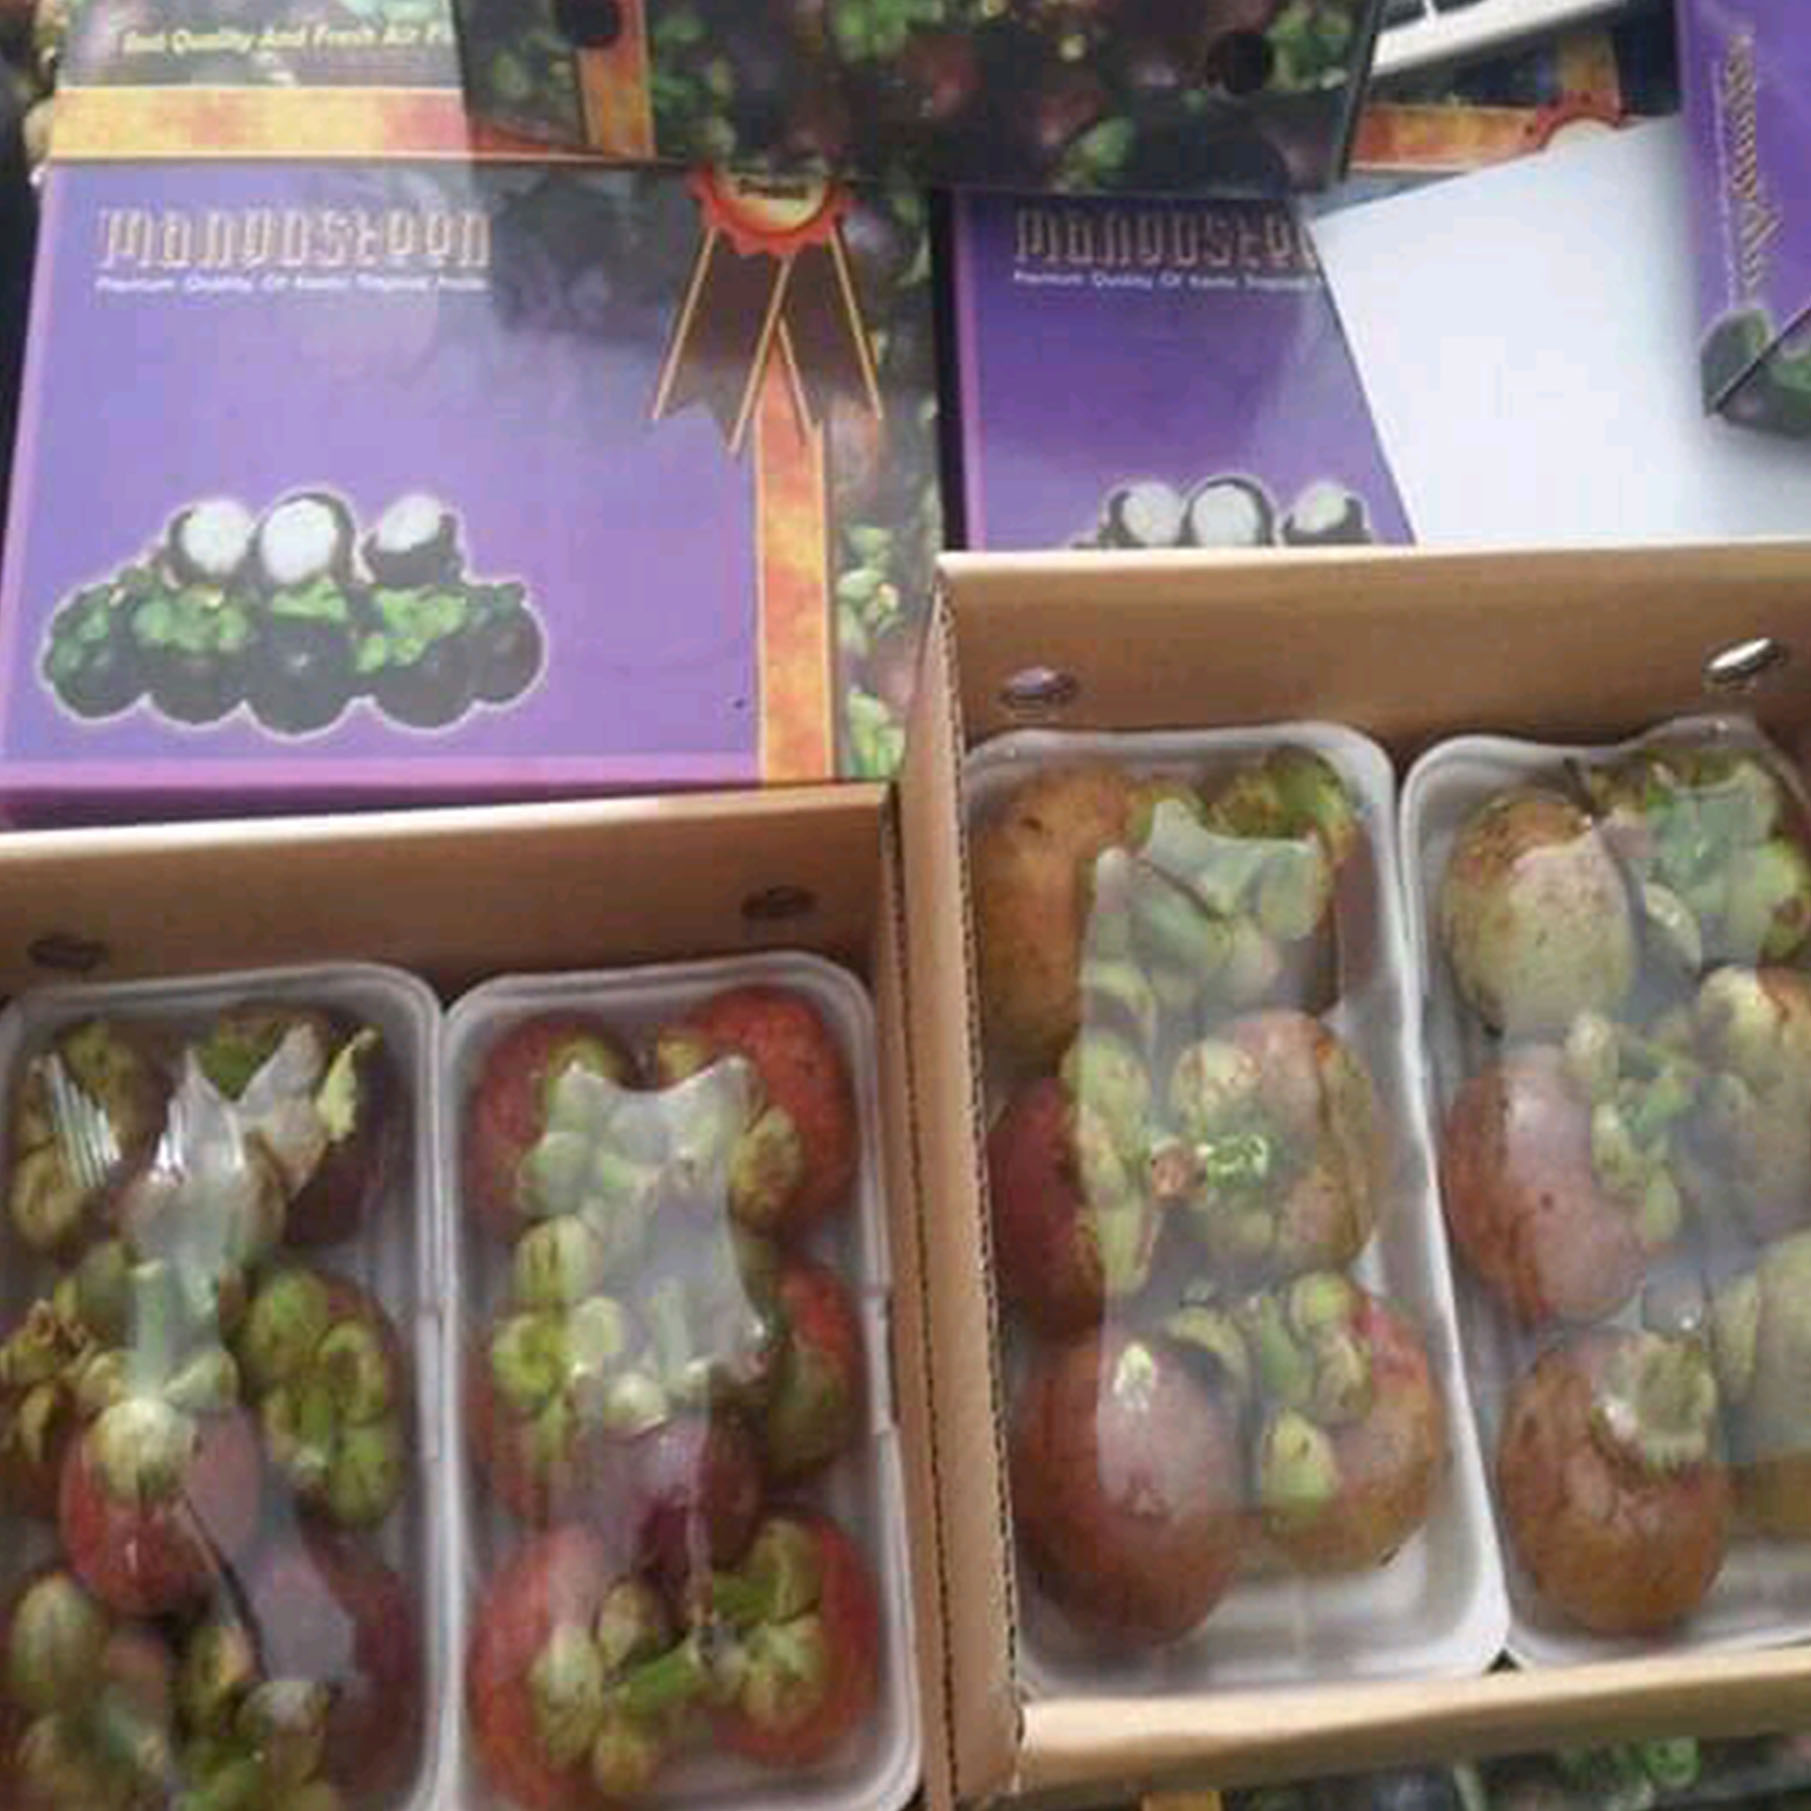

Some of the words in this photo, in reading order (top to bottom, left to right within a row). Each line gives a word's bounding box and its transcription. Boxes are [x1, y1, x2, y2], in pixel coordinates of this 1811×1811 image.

[172, 27, 253, 55] Quality
[258, 26, 306, 48] And
[311, 23, 377, 48] Fresh
[183, 274, 253, 296] Quality
[1091, 269, 1153, 290] Quality
[1159, 269, 1183, 288] Of
